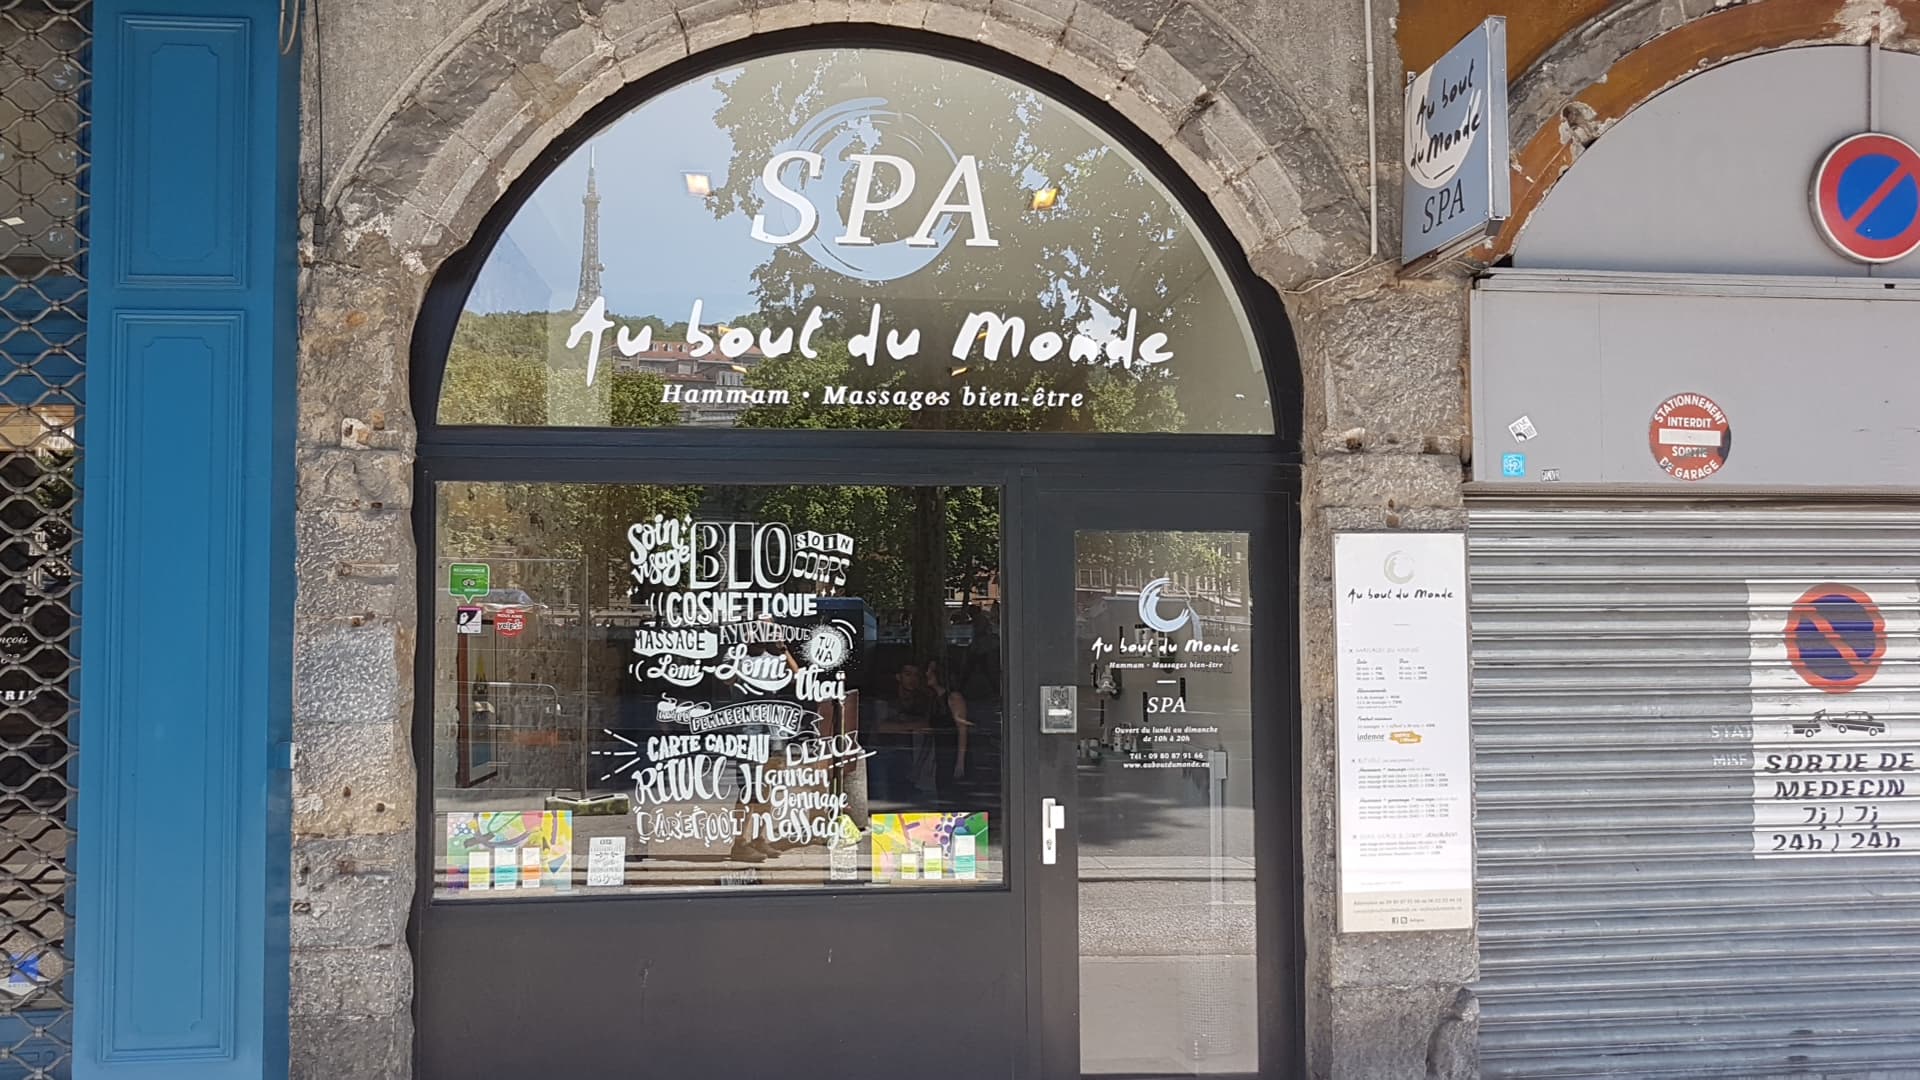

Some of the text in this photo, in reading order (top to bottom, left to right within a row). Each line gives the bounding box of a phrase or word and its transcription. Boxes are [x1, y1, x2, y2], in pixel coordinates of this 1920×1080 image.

[1416, 58, 1474, 140] Au bout
[1411, 105, 1480, 169] du Monde
[751, 149, 998, 247] SPA
[1422, 178, 1465, 234] SPA
[566, 296, 1175, 386] Au bout du Monde
[661, 384, 1084, 408] Hammam Massages bien-être
[1654, 395, 1726, 424] STATIONNEMENT
[1668, 417, 1712, 428] INTERDIT
[1672, 446, 1707, 457] SORTIE
[1660, 457, 1719, 480] DE GARAGE
[628, 513, 684, 565] Soin
[795, 530, 853, 555] SOIN
[690, 521, 794, 590] BIO
[793, 551, 849, 586] CORPS
[1348, 588, 1453, 604] Au bout du Monde
[667, 591, 817, 626] COSMETIQUE
[635, 629, 705, 651] MASSAGE
[819, 636, 835, 648] TUI
[1091, 637, 1240, 660] Au bout du Monde
[816, 648, 832, 662] NA
[1152, 662, 1187, 670] Massages
[1190, 661, 1223, 669] bien-être
[1147, 697, 1186, 713] SPA
[1152, 726, 1171, 734] lundi
[1184, 725, 1218, 734] dimanche
[647, 734, 770, 763] CARTE CADEAU
[1765, 752, 1914, 773] SORTIE DE
[1775, 779, 1905, 799] MEDECIN
[1773, 834, 1822, 851] 24h
[1851, 832, 1901, 850] 24h
